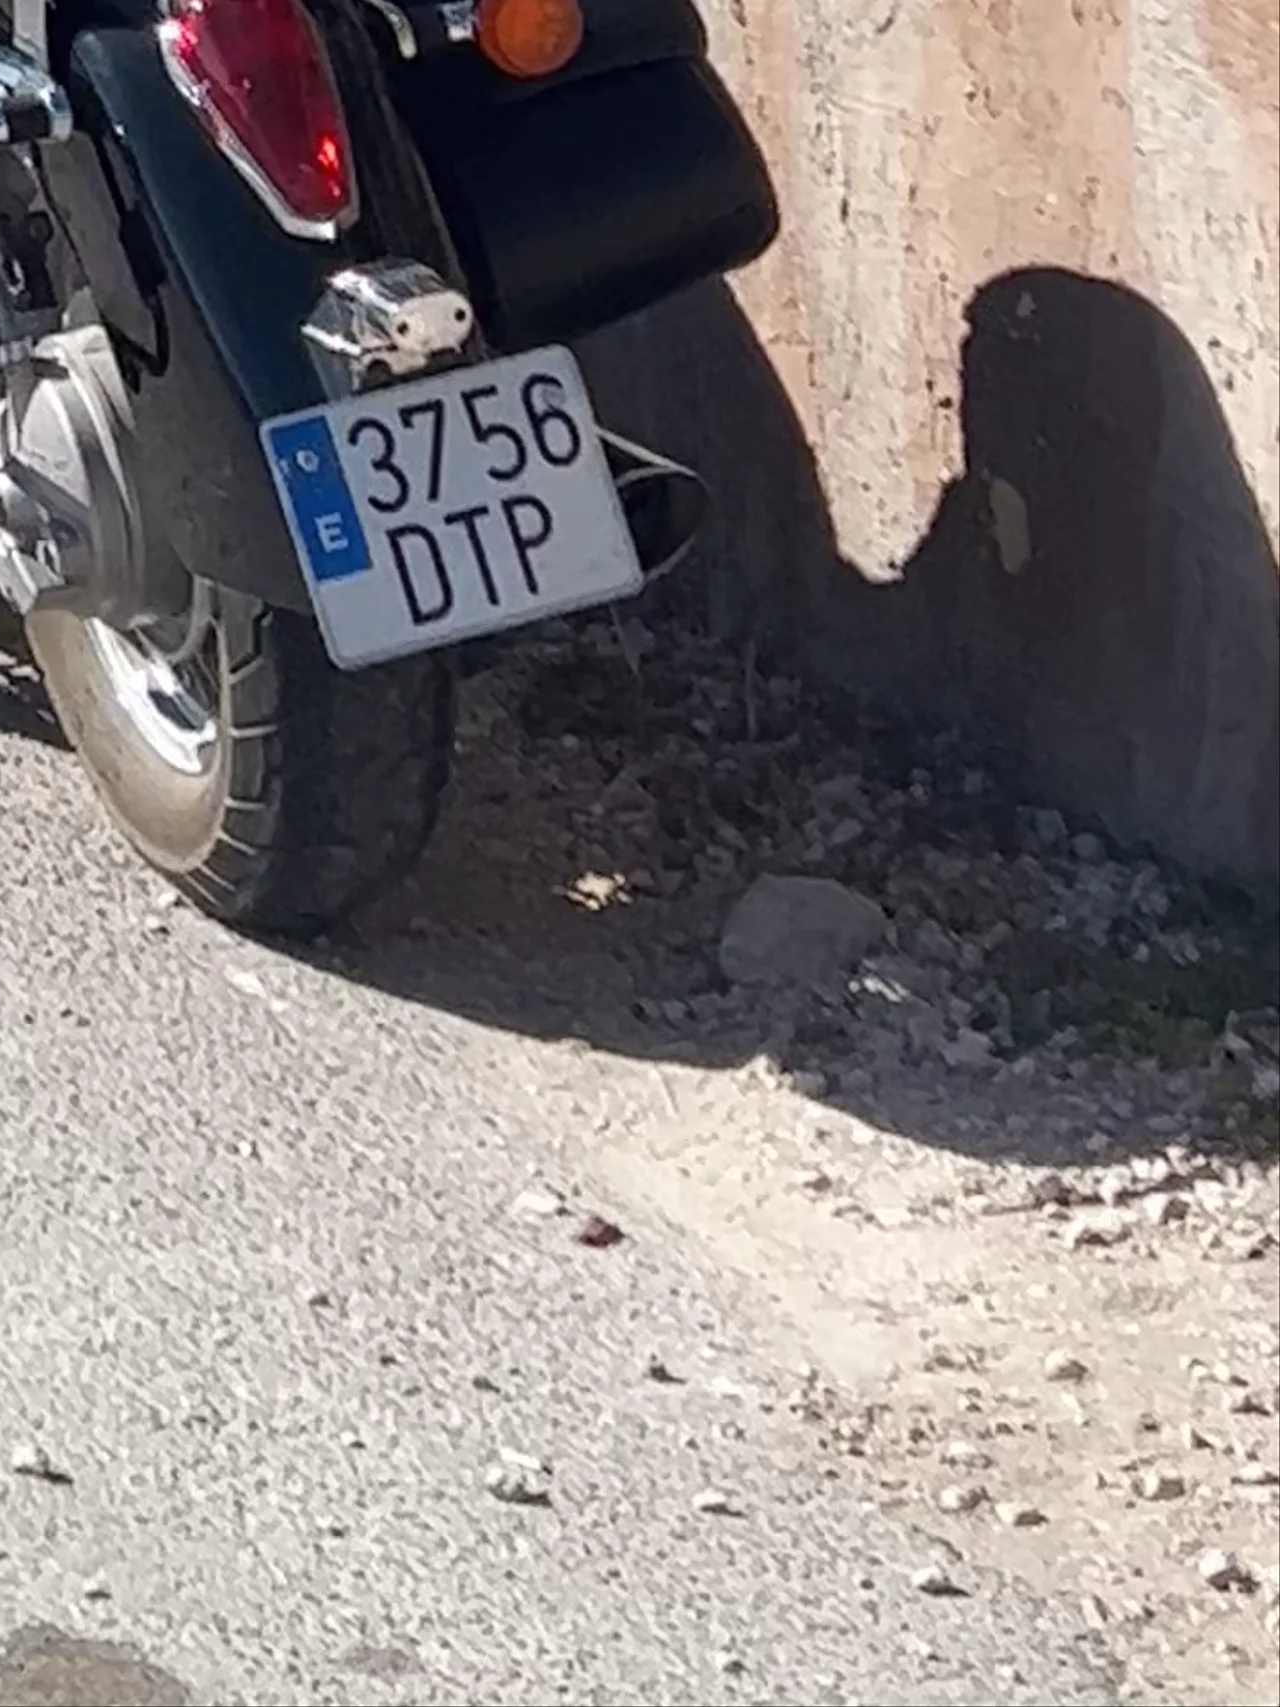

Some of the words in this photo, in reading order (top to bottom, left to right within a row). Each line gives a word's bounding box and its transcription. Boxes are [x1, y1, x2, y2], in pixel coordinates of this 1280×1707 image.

[347, 372, 581, 514] 3756
[314, 511, 349, 554] E
[385, 494, 554, 626] DTP
